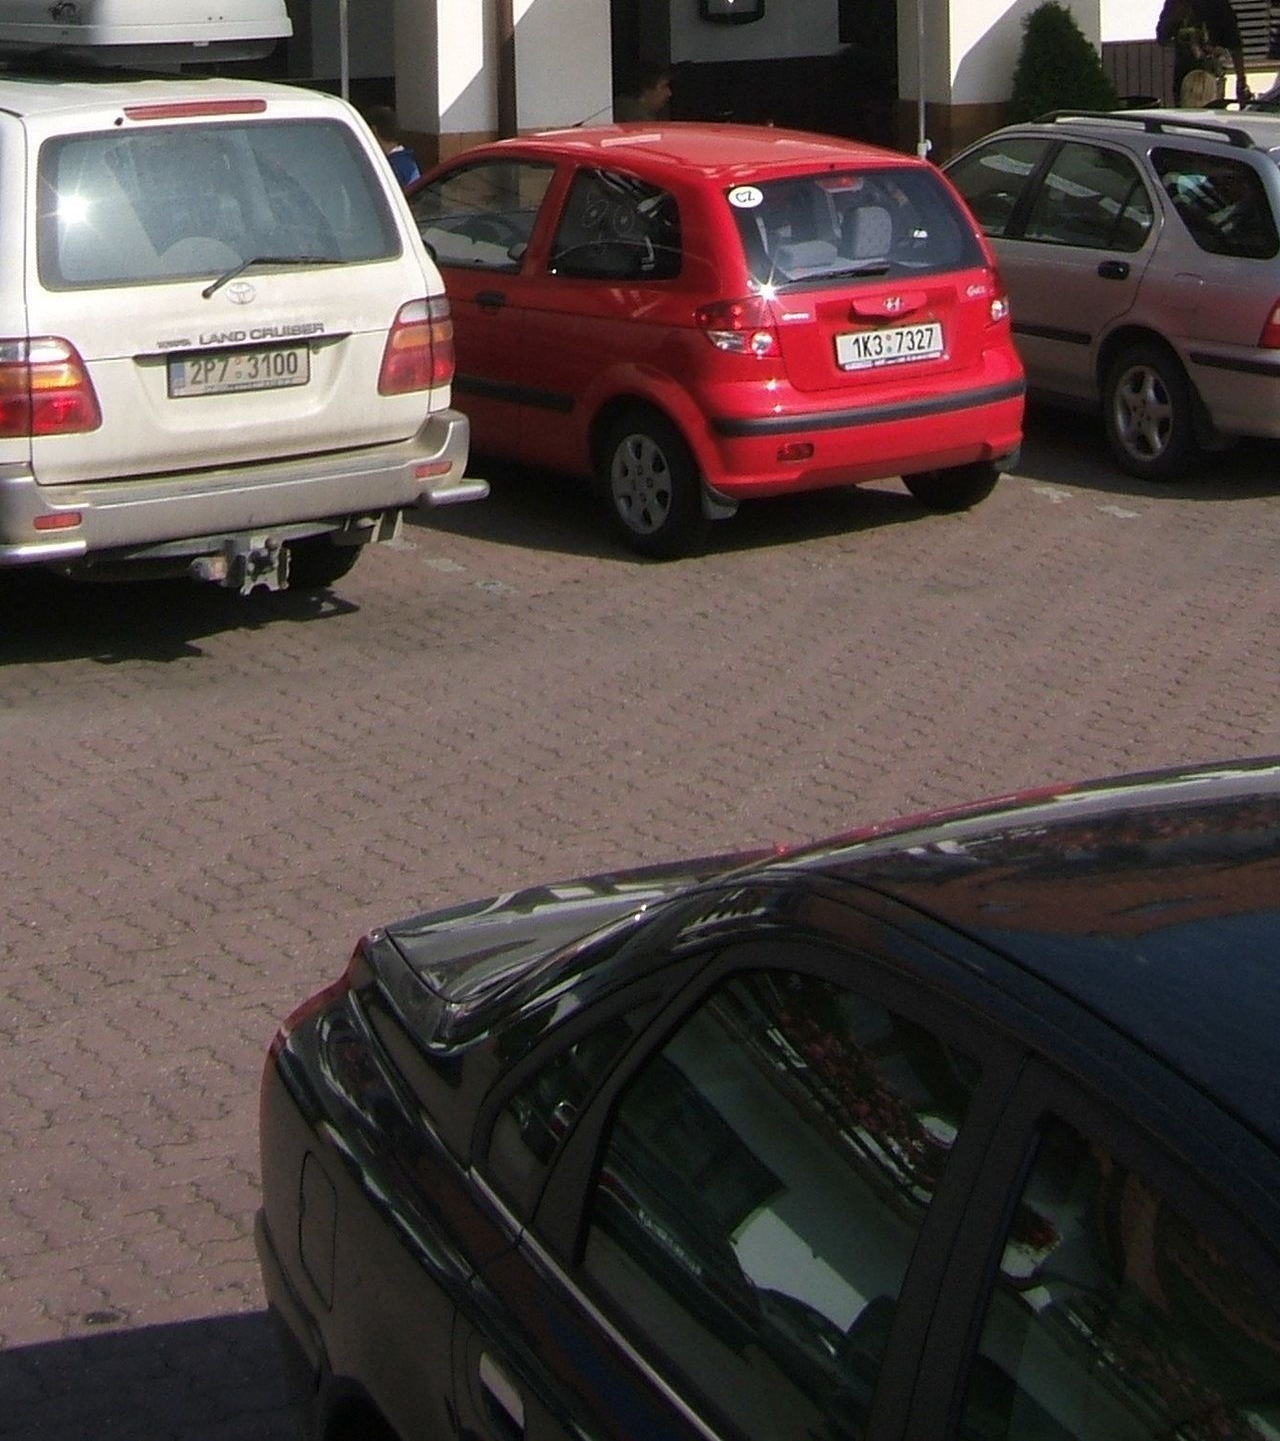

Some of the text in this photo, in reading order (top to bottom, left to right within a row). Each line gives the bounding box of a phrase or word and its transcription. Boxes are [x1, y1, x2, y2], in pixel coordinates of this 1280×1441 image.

[735, 190, 756, 203] CZ
[198, 330, 247, 345] LAND
[250, 322, 325, 340] CRUISER
[852, 327, 934, 359] 1K3 7327
[190, 357, 229, 386] 2P7
[247, 351, 299, 379] 3100
